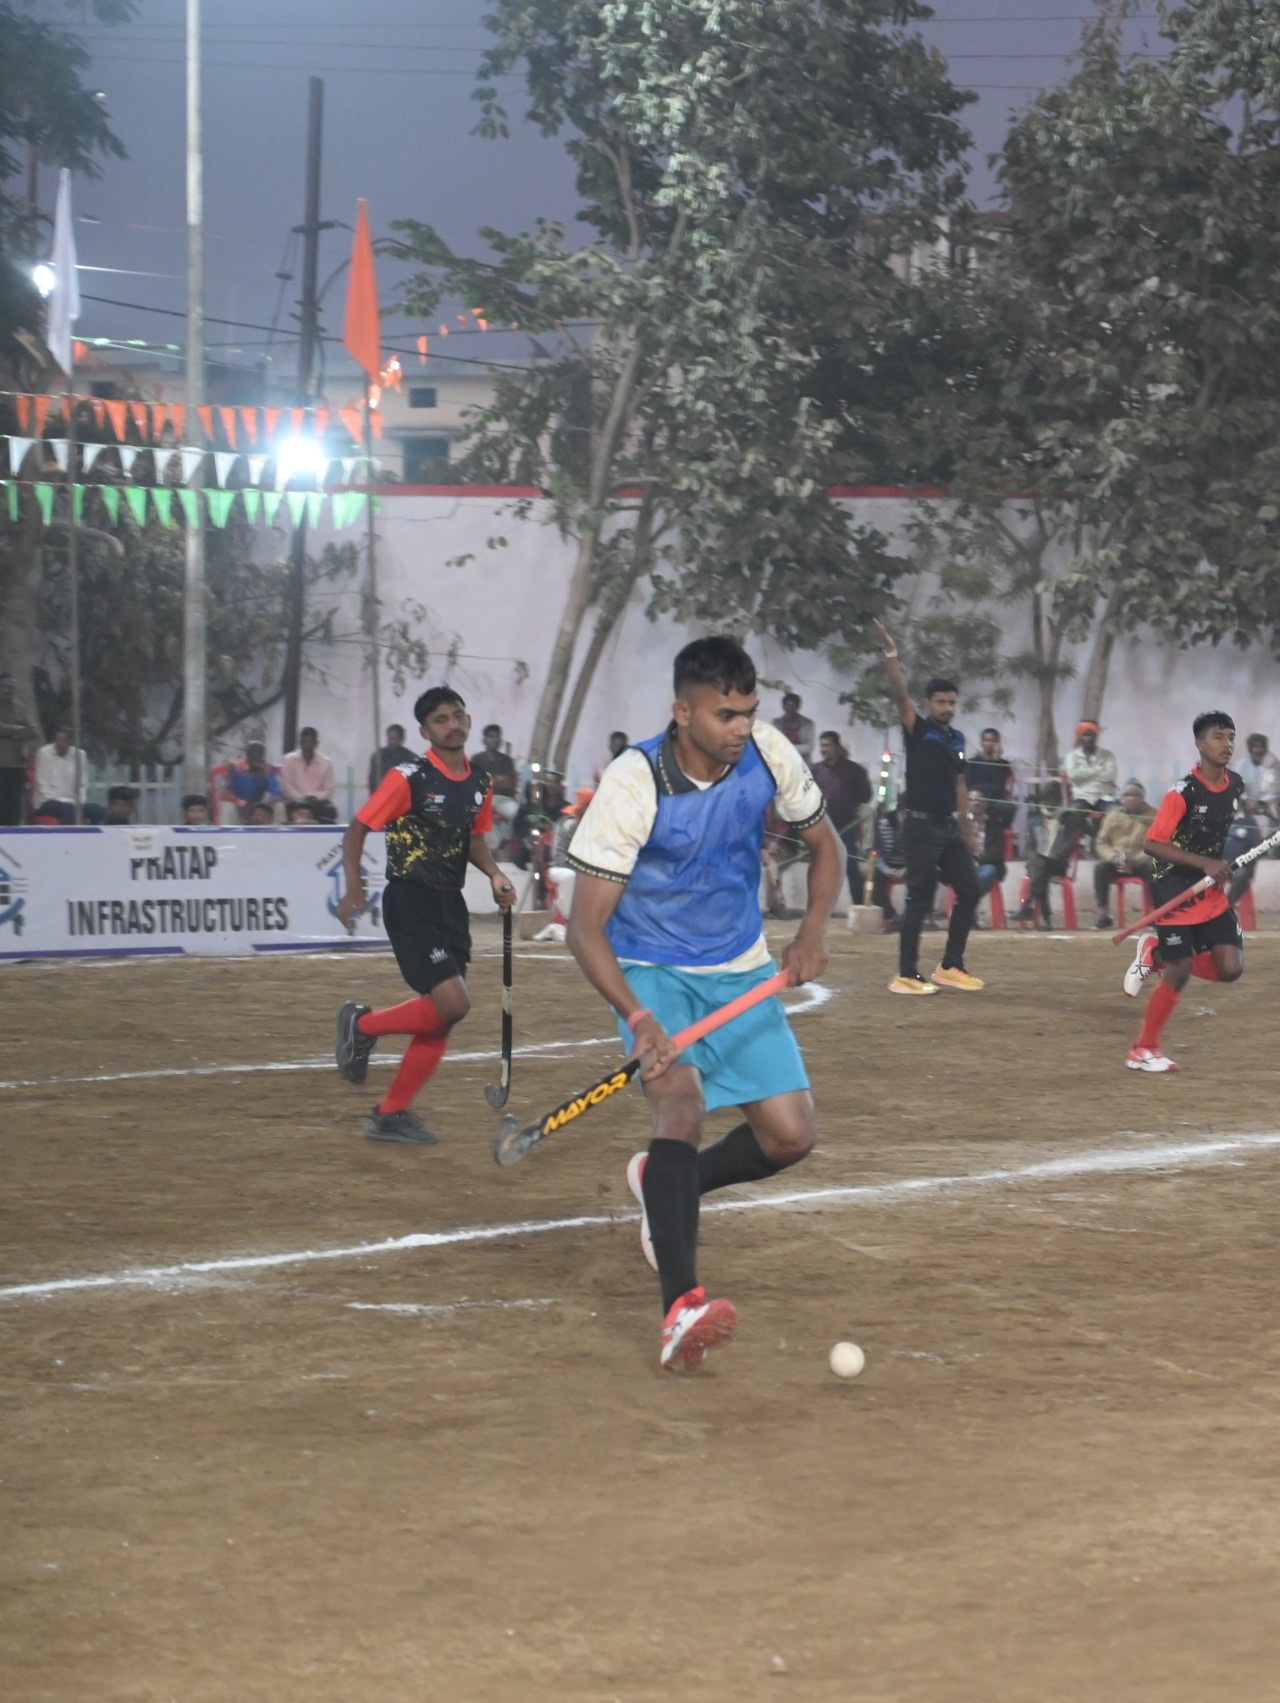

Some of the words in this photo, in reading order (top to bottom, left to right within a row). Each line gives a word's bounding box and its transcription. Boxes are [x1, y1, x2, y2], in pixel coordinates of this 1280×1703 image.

[130, 846, 218, 880] PRATAP
[67, 897, 288, 936] INFRASTRUCTURES
[543, 1072, 627, 1135] MAYOR
